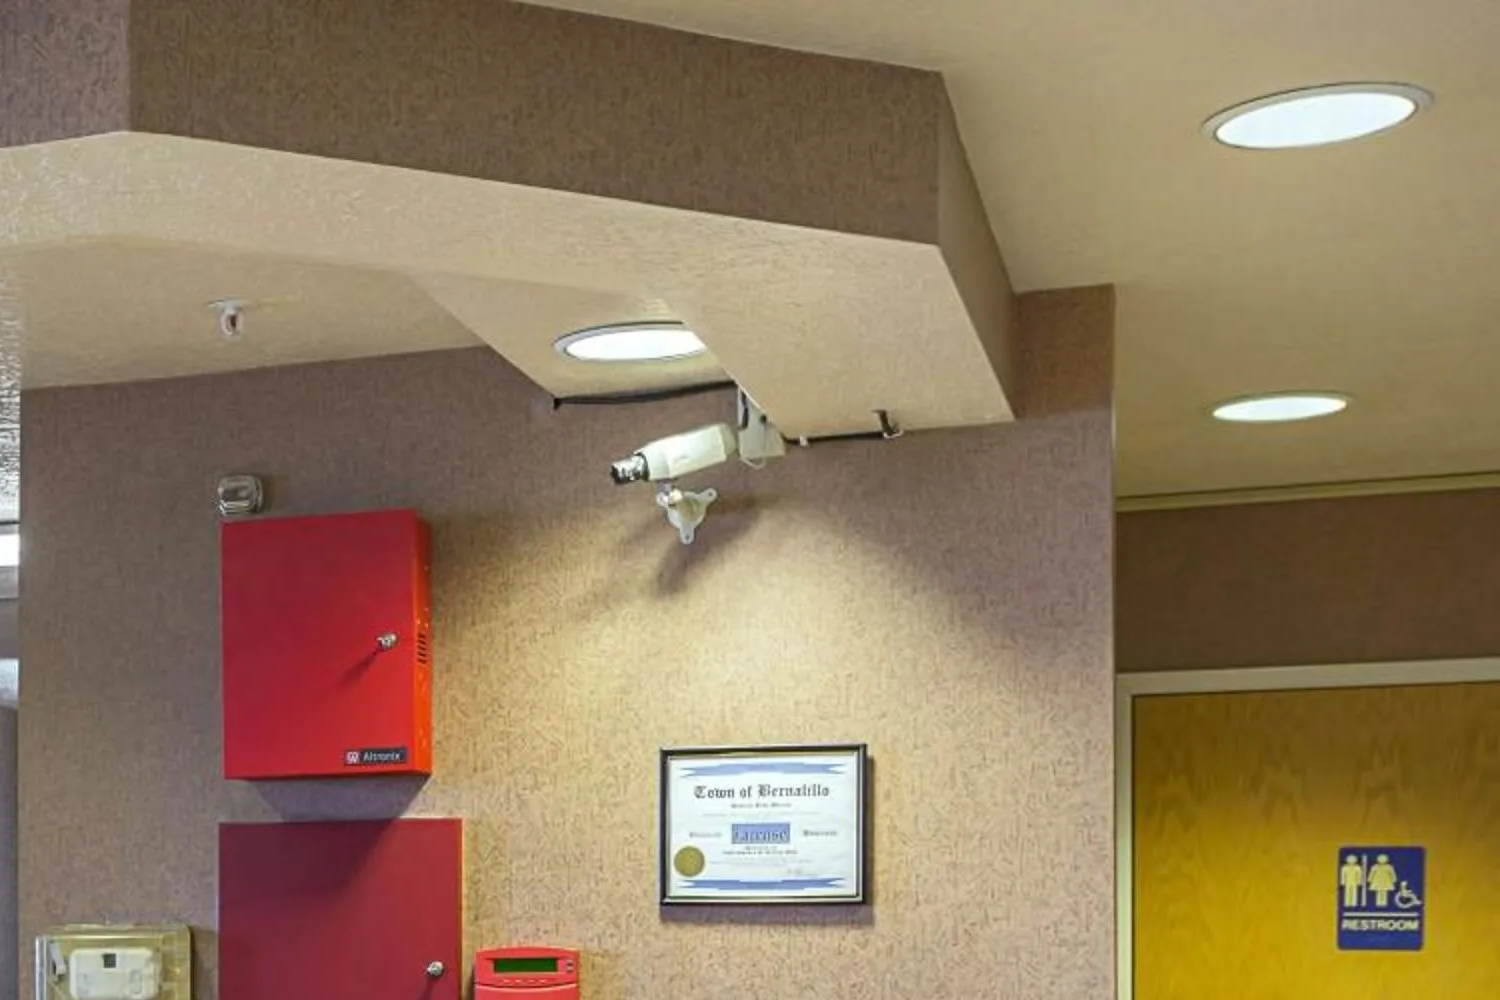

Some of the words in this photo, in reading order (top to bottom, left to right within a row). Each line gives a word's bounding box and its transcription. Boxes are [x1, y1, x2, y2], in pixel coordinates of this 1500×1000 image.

[363, 751, 400, 762] Altronix
[694, 785, 735, 799] Town
[739, 785, 752, 798] of
[758, 783, 830, 797] Bernalillo
[1342, 919, 1419, 931] RESTROOM
